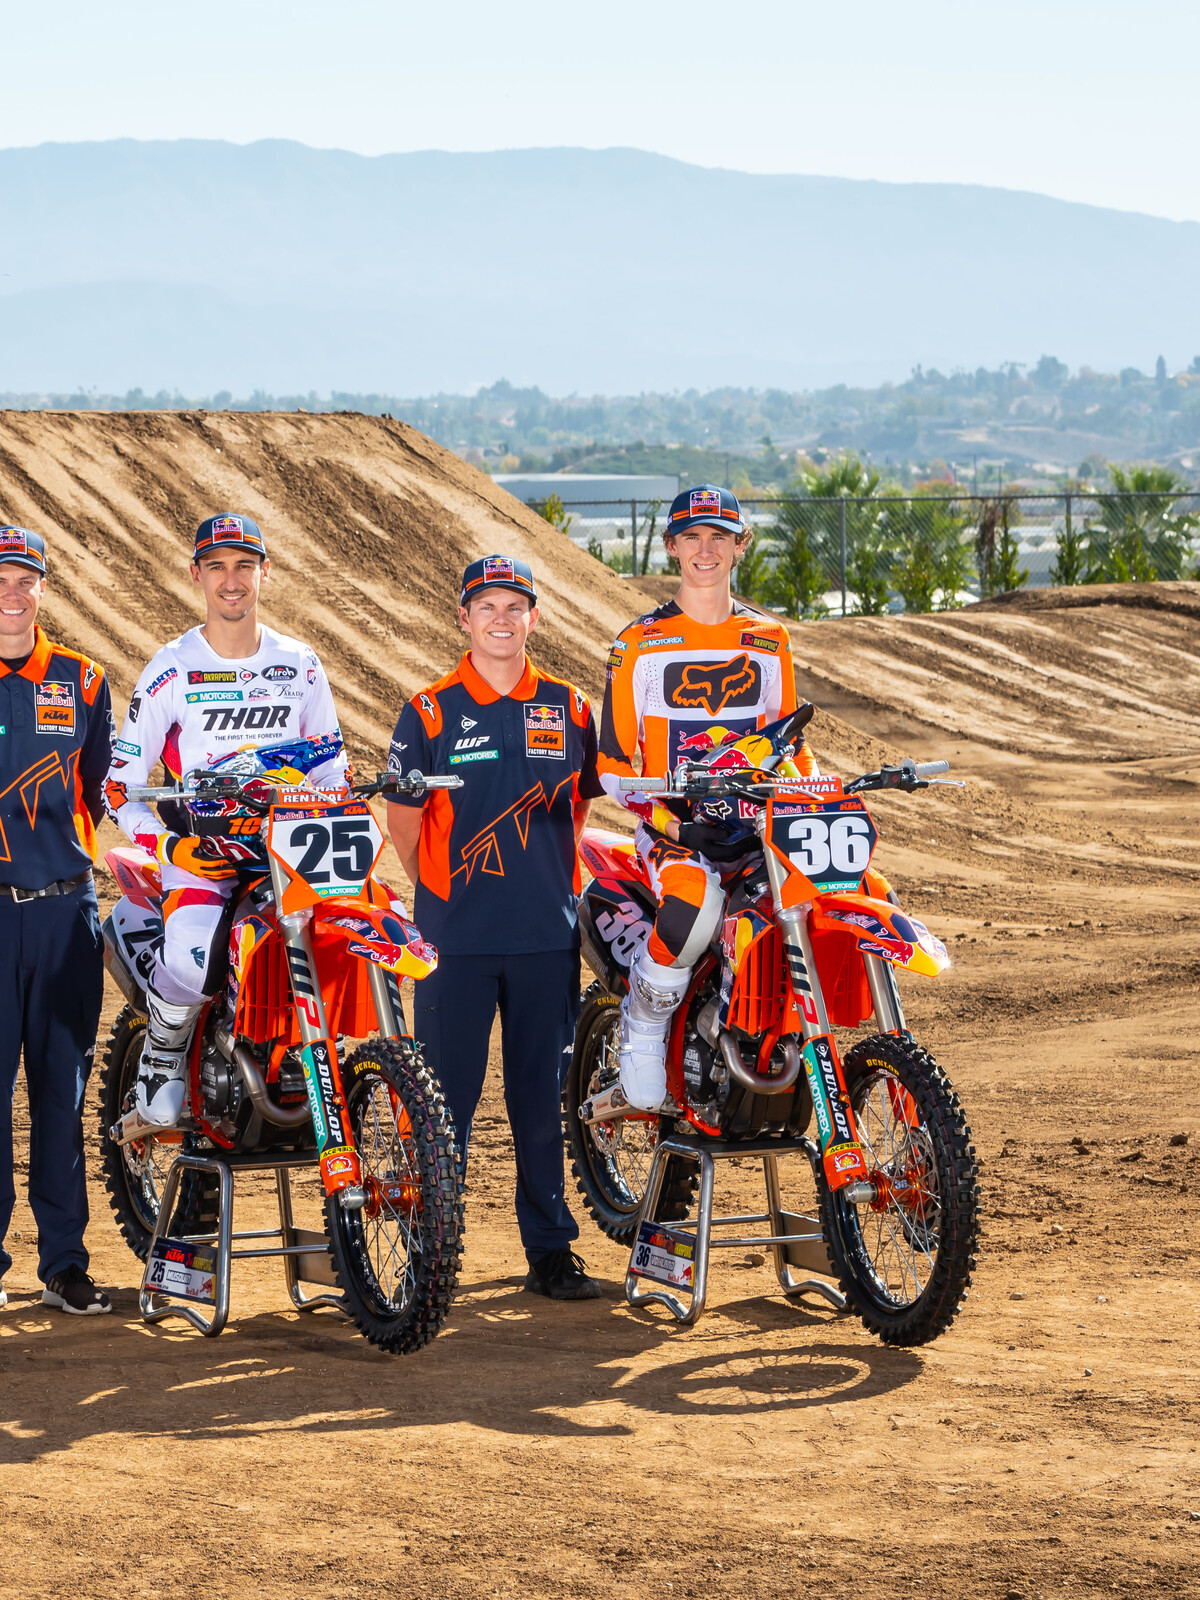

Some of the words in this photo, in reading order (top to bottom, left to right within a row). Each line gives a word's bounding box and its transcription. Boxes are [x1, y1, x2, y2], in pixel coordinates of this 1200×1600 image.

[648, 636, 683, 646] MOTOREX
[265, 667, 294, 677] Airoh
[146, 667, 177, 695] PARTS
[37, 695, 55, 706] Red
[56, 695, 73, 707] Bull
[200, 691, 239, 701] MOTOREX
[43, 710, 69, 721] KTM
[202, 705, 291, 731] THOR
[39, 724, 57, 732] FACTORY
[58, 725, 74, 734] RACING
[527, 719, 545, 729] Red
[545, 719, 562, 730] Bull
[533, 734, 558, 745] KTM
[308, 746, 335, 758] AIROH
[462, 751, 497, 762] MOTOREX
[528, 749, 547, 757] FACTORY
[548, 749, 563, 757] RACING
[344, 806, 367, 815] KTM
[773, 806, 787, 815] Red
[787, 804, 802, 813] Bull
[840, 802, 861, 810] KTM
[275, 812, 289, 820] Red
[289, 811, 304, 819] Bull
[290, 820, 374, 884] 25
[789, 817, 870, 876] 36
[329, 887, 359, 895] MOTOREX
[828, 882, 858, 890] MOTOREX
[595, 901, 654, 967] 36
[354, 1061, 382, 1076] DUNLOP
[306, 1078, 325, 1140] MOTOREX
[809, 1075, 830, 1136] MOTOREX
[895, 1180, 908, 1190] 36
[388, 1188, 401, 1198] 25
[650, 1233, 667, 1248] KTM
[165, 1248, 185, 1263] KTM
[636, 1245, 651, 1267] 36
[151, 1260, 166, 1283] 25
